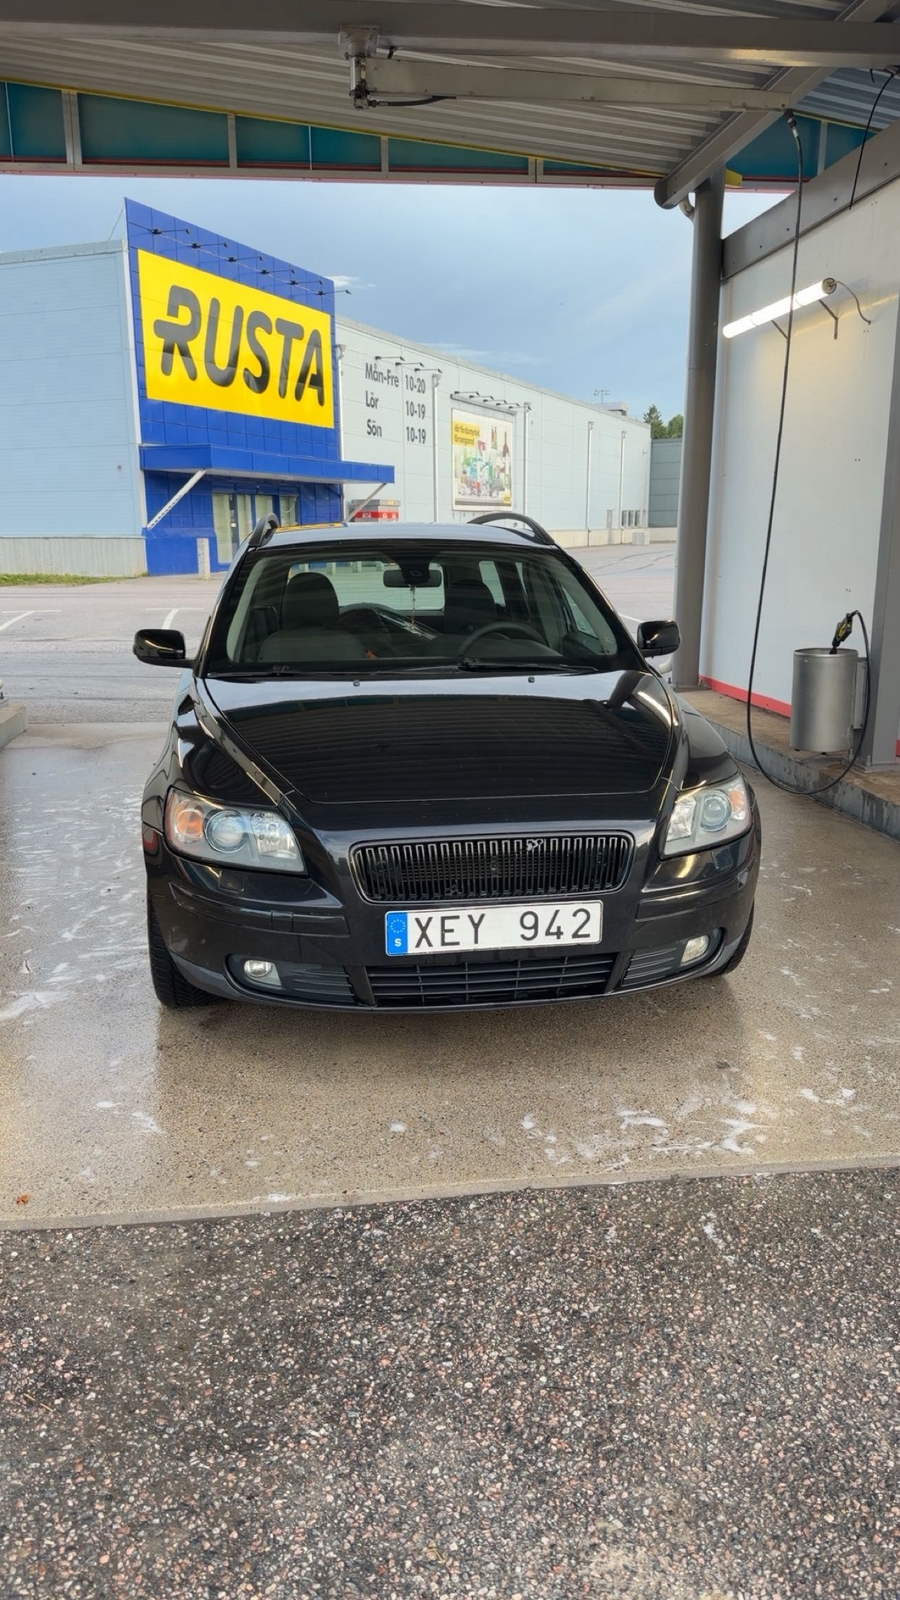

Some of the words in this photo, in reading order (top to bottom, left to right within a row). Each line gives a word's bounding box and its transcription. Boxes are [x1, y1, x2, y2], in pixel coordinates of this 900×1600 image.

[153, 284, 325, 407] RUSTA
[365, 362, 400, 388] Mån-Fre
[405, 374, 426, 394] 10-20
[365, 390, 379, 409] Lör
[406, 400, 426, 420] 10-19
[366, 418, 383, 438] Sön
[406, 426, 427, 444] 10-19
[394, 938, 402, 947] S
[414, 913, 486, 948] XEY
[519, 908, 591, 941] 942
